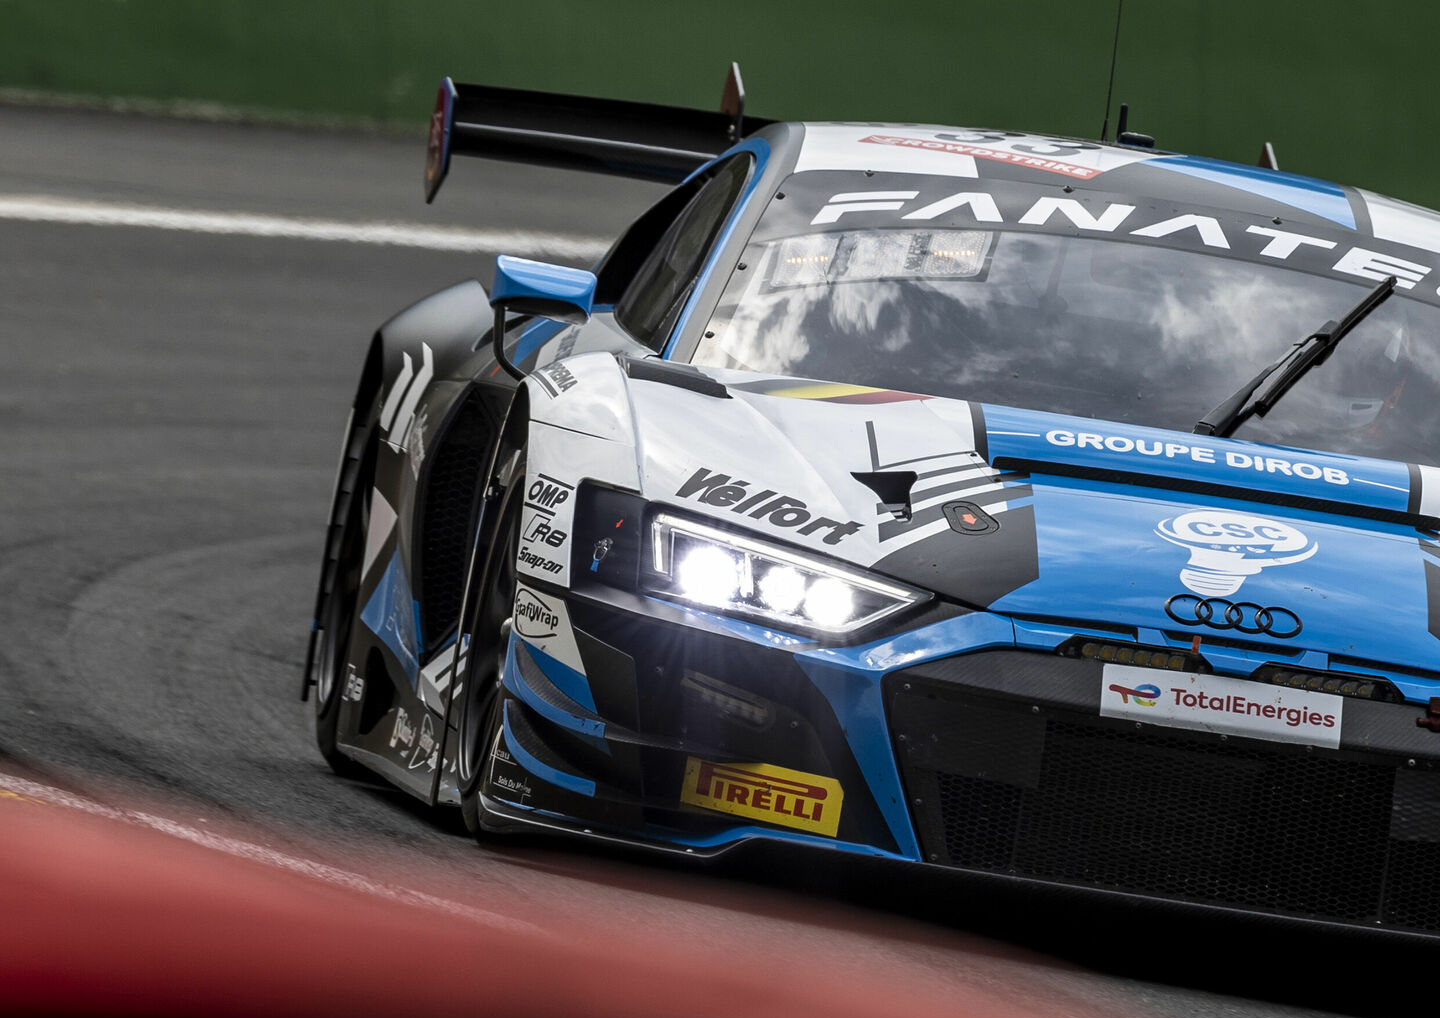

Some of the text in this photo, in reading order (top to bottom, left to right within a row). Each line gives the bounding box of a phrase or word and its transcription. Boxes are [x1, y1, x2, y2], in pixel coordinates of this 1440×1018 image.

[1045, 430, 1350, 485] GROUPE DIROB
[528, 480, 569, 508] OMP
[529, 519, 567, 548] R8
[1187, 520, 1288, 542] CSC
[1170, 687, 1336, 728] TotalEnergies
[696, 760, 828, 822] PIRELLI
